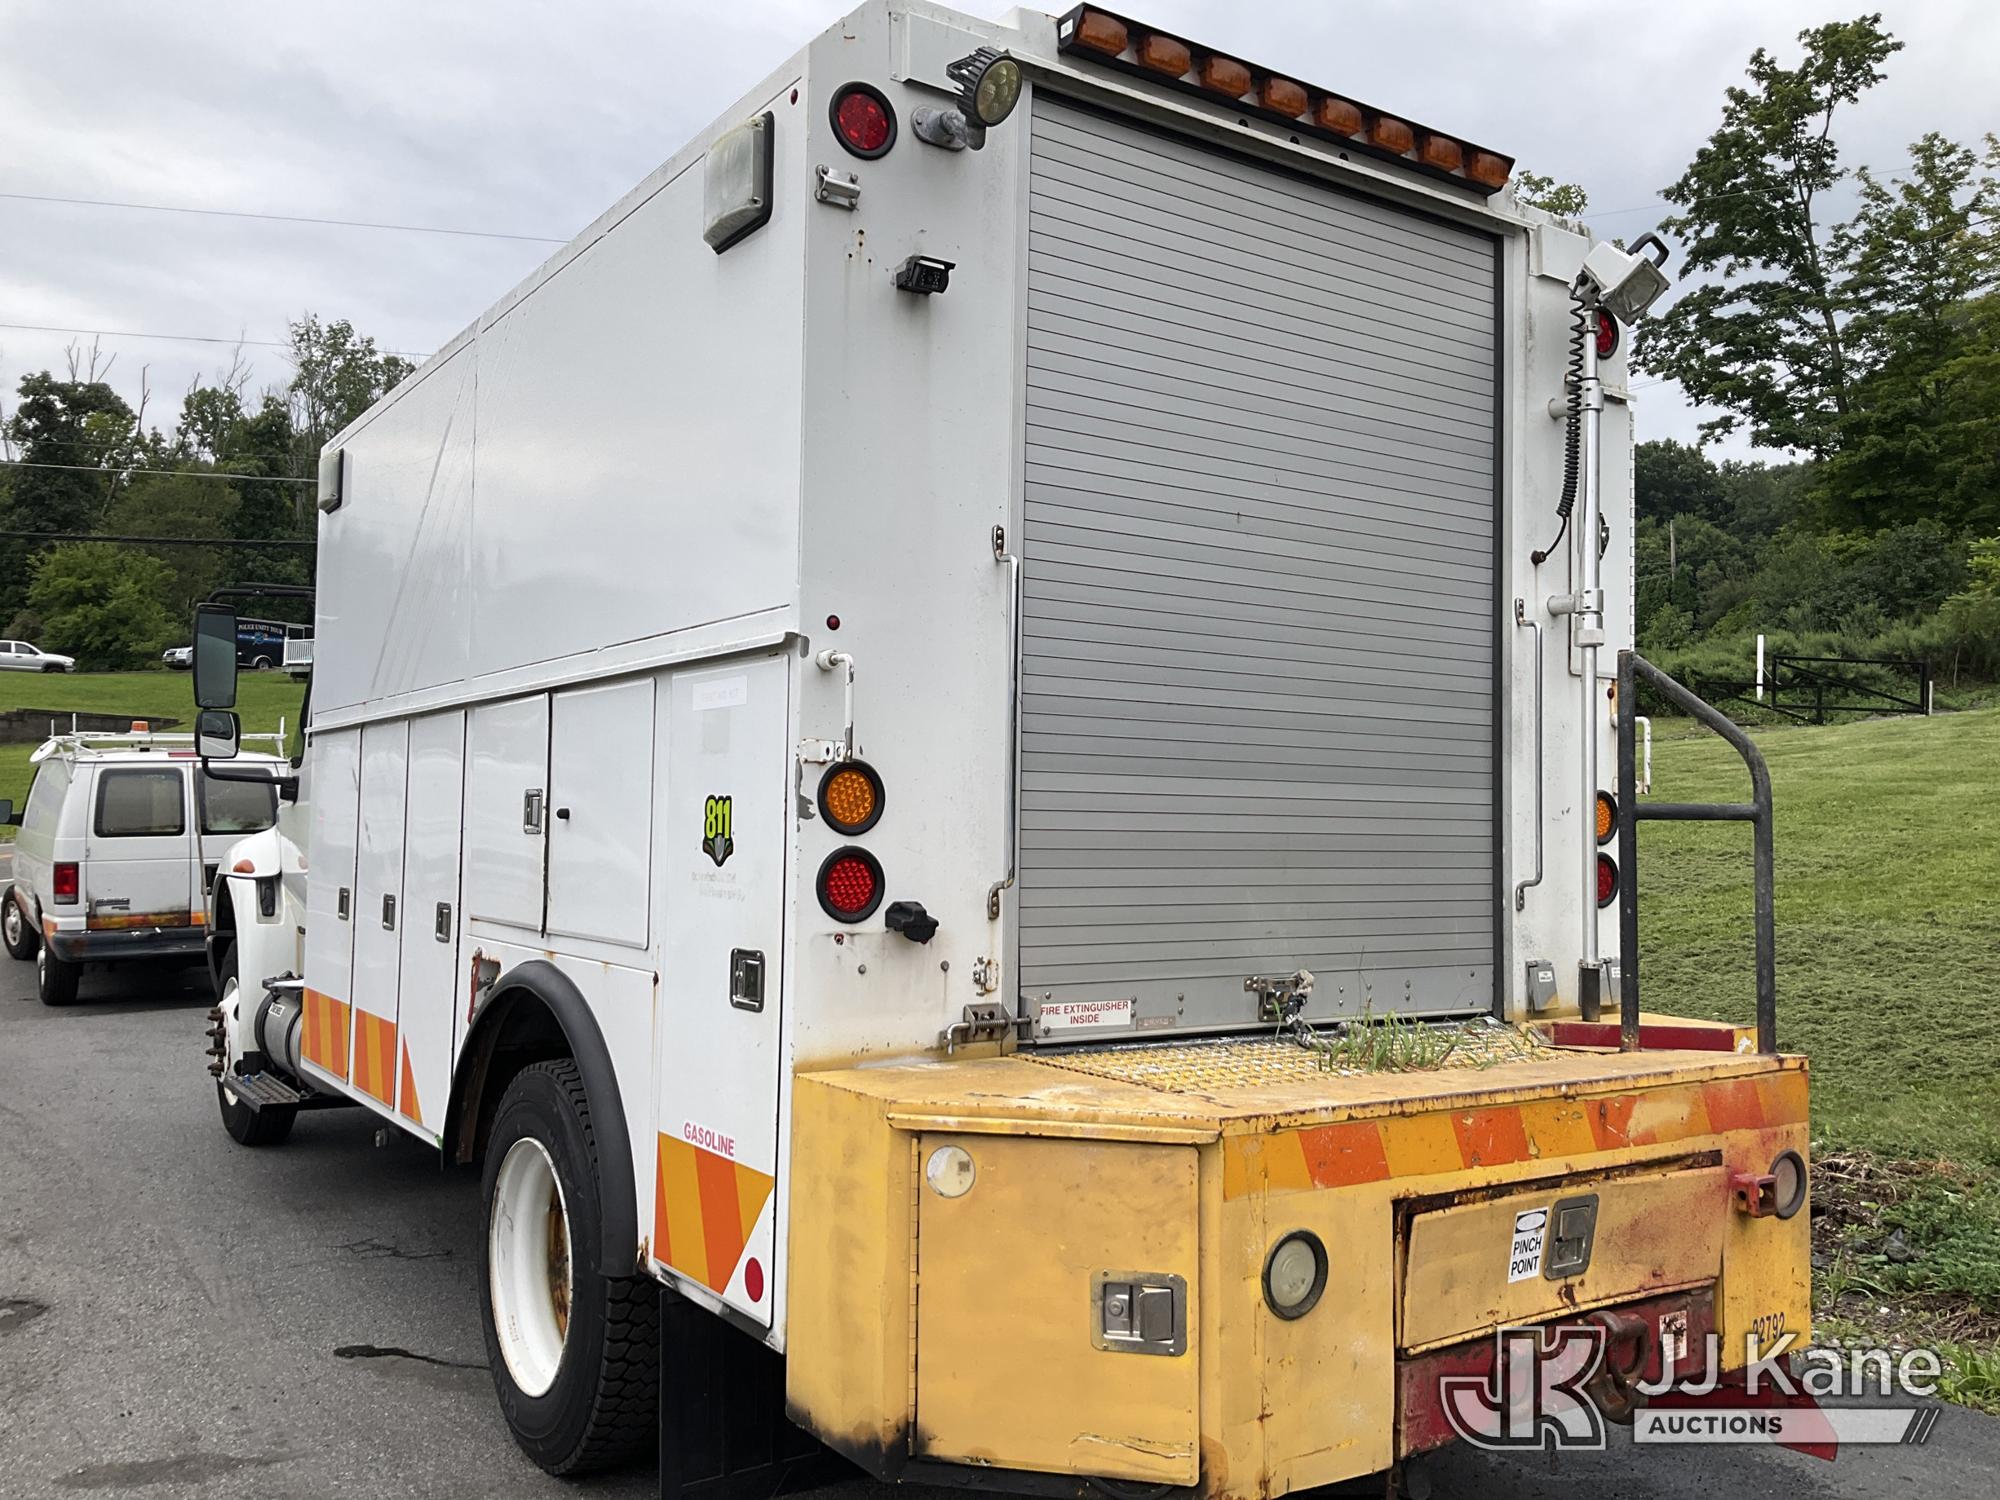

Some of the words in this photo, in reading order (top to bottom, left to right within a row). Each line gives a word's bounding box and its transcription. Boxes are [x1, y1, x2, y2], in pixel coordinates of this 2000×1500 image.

[705, 795, 731, 839] 811
[1040, 1005, 1061, 1016] FIRE
[1063, 1001, 1129, 1015] EXTINGUISHER
[1070, 1014, 1100, 1025] INSIDE
[683, 1122, 735, 1157] GASOLINE
[1513, 1236, 1542, 1256] PINCH
[1510, 1256, 1540, 1276] POINT
